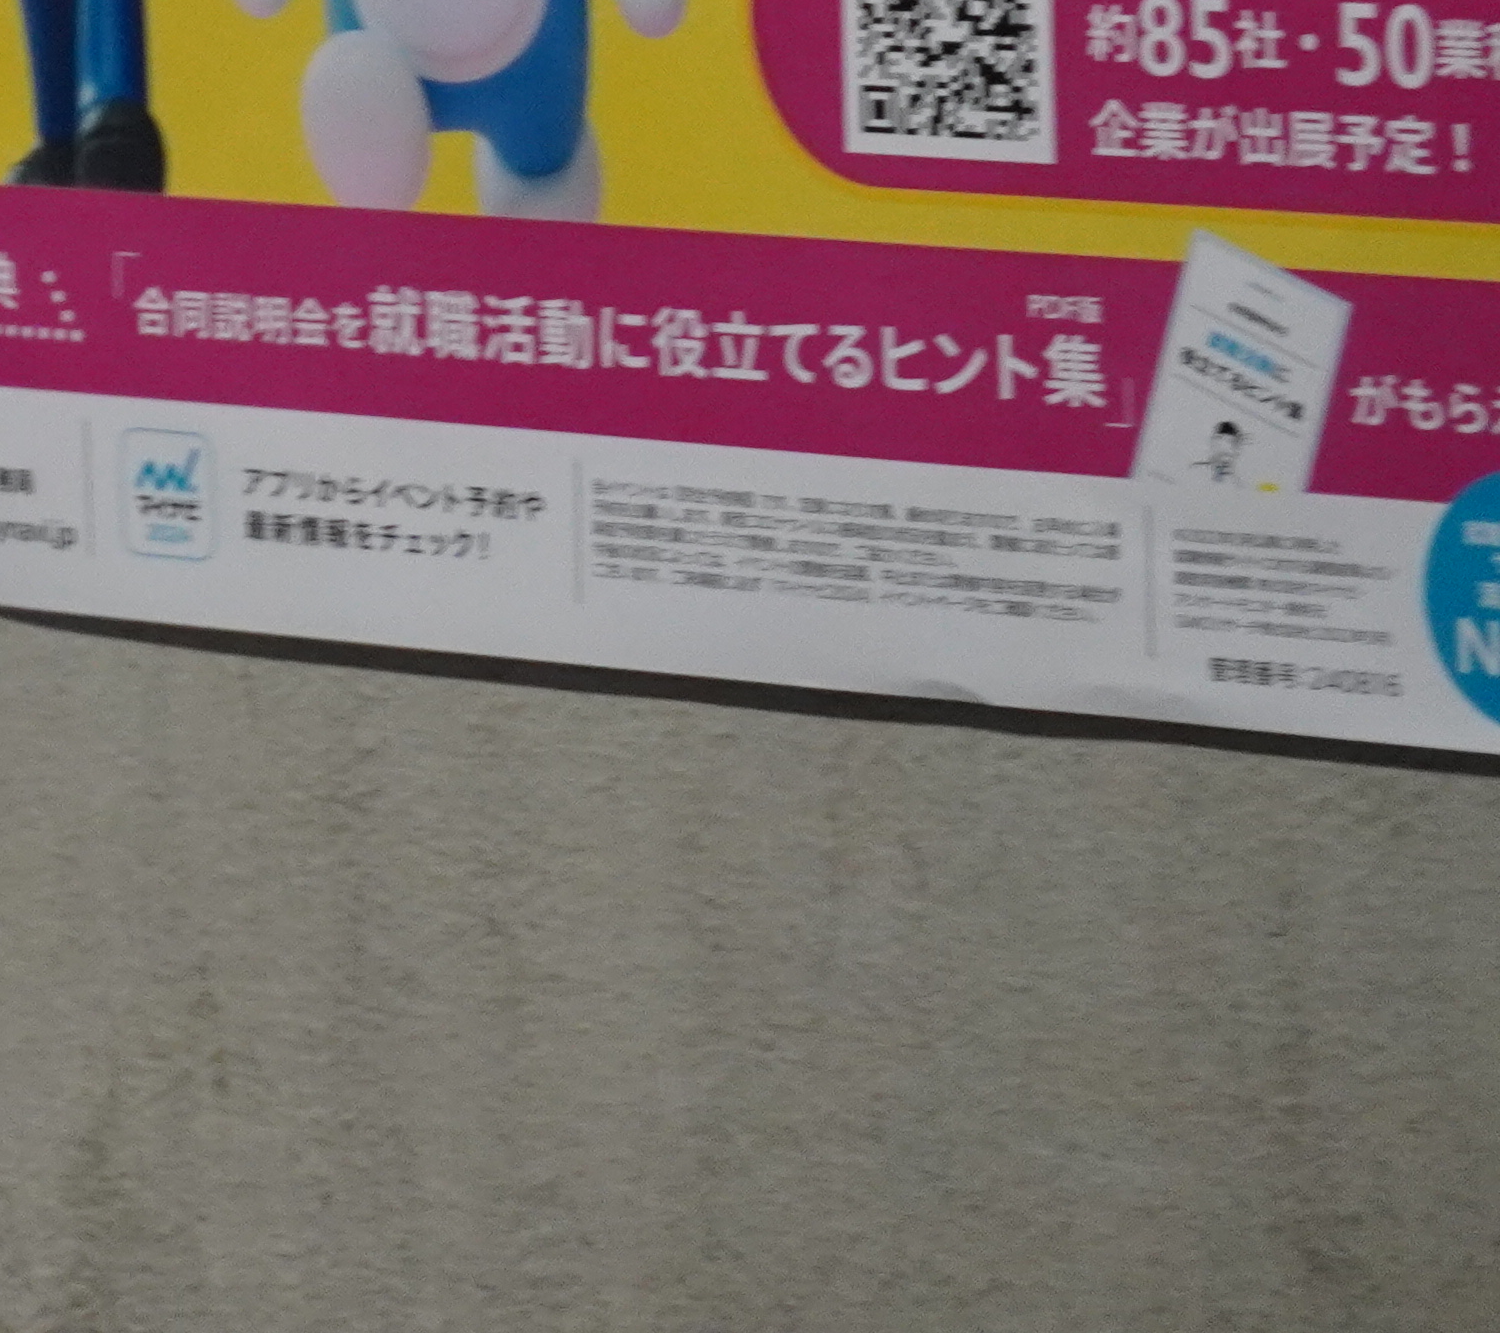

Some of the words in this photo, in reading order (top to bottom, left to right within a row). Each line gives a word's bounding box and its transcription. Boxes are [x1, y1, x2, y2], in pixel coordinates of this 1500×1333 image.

[1089, 99, 1474, 175] 企業が出展予定!
[1349, 375, 1500, 434] がもら
